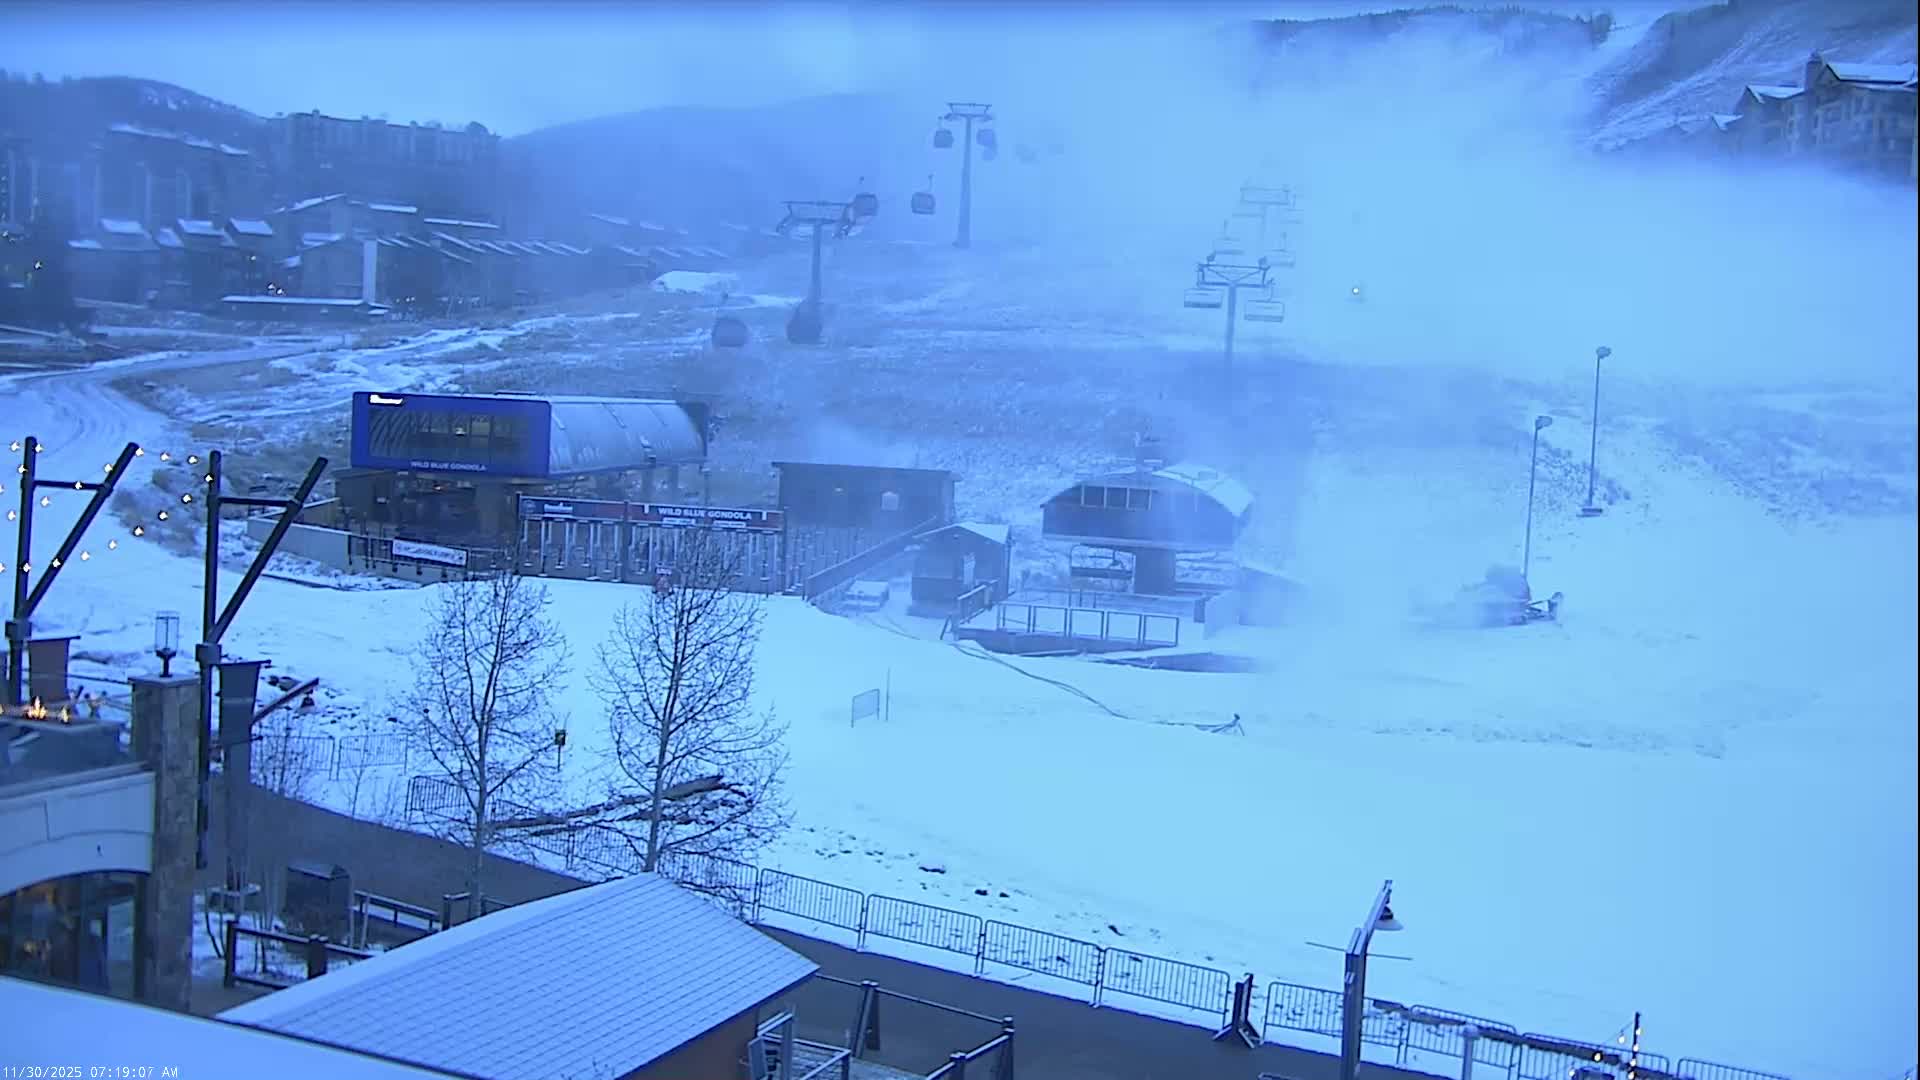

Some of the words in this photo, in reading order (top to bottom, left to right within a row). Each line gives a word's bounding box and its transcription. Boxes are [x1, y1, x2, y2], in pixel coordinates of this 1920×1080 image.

[450, 463, 487, 472] GONDOLA
[658, 507, 682, 516] WILD
[683, 508, 705, 517] BLUE
[708, 510, 752, 520] GONDOLA
